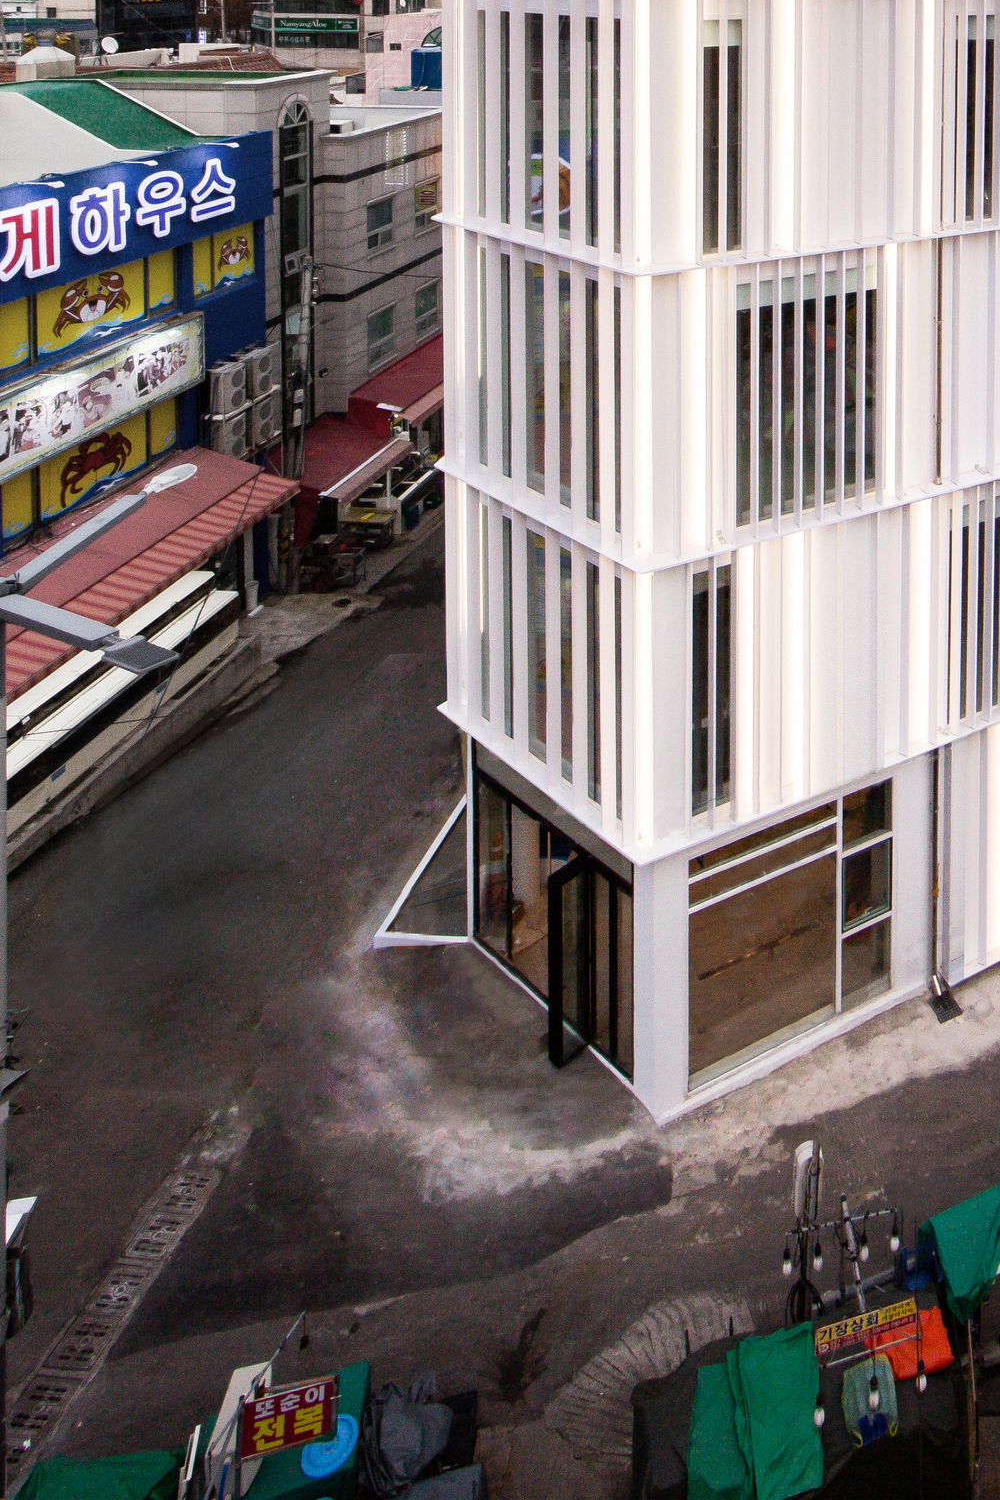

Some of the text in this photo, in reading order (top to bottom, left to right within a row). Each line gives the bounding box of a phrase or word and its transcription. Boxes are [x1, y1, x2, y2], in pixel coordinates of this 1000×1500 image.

[819, 1312, 878, 1341] 기장상회
[254, 1384, 326, 1420] 또순이
[252, 1402, 324, 1452] 전복
